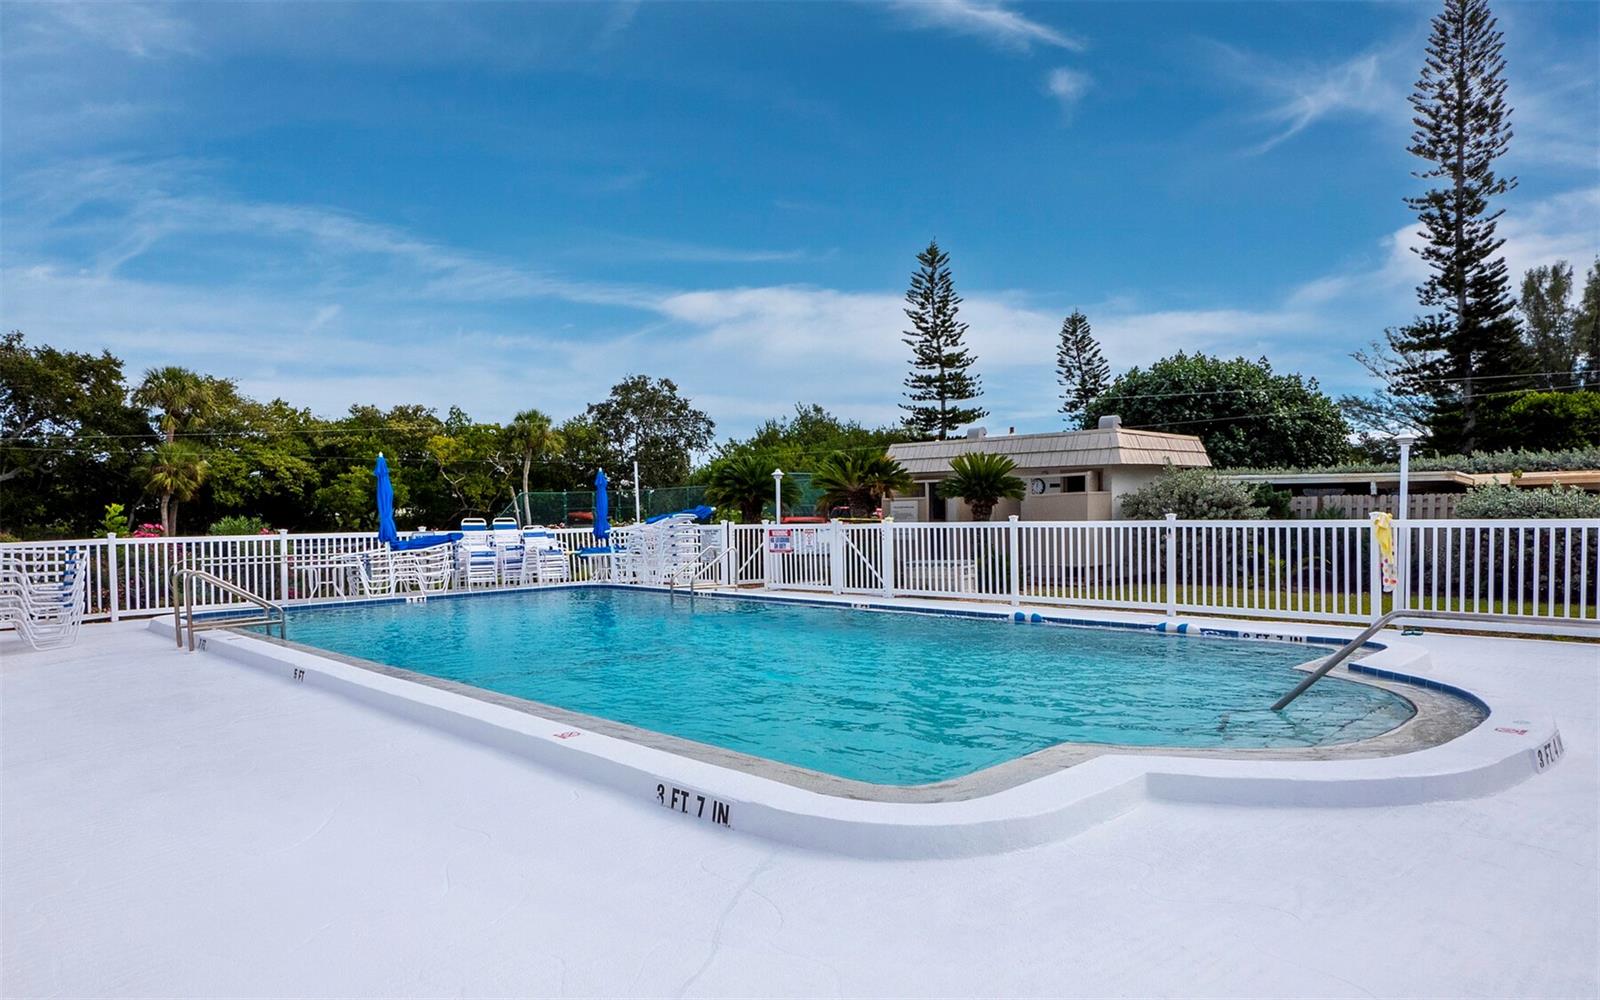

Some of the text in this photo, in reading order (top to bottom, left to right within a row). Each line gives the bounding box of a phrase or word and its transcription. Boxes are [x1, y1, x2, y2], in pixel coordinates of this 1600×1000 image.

[1538, 749, 1545, 768] 3
[656, 783, 665, 806] 3
[697, 795, 706, 818] 7
